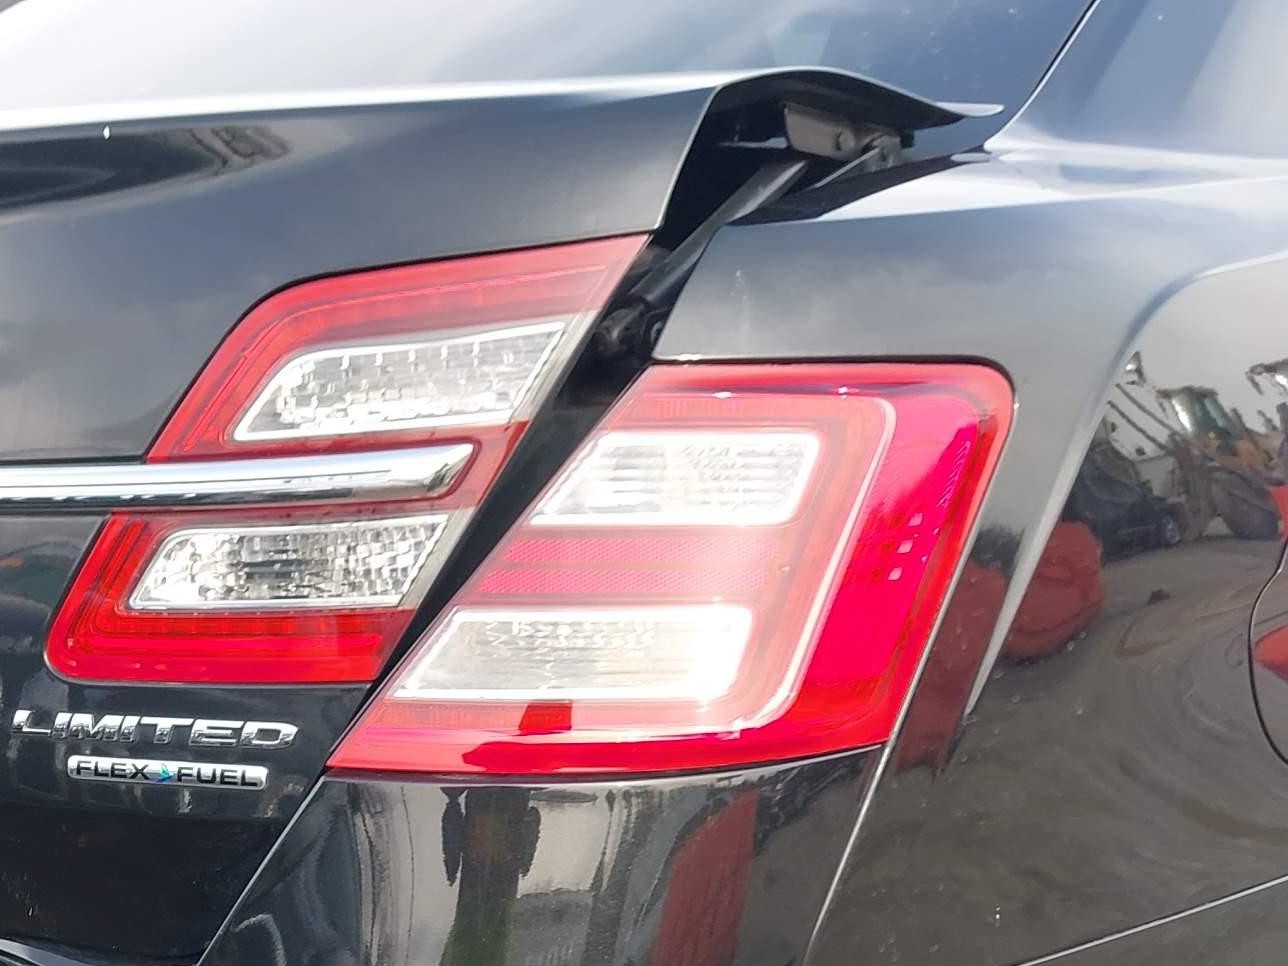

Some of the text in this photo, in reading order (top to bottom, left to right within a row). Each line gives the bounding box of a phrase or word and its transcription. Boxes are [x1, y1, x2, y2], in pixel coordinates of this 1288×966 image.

[12, 709, 300, 749] LIMITED
[75, 759, 259, 787] FLEX FUEL
